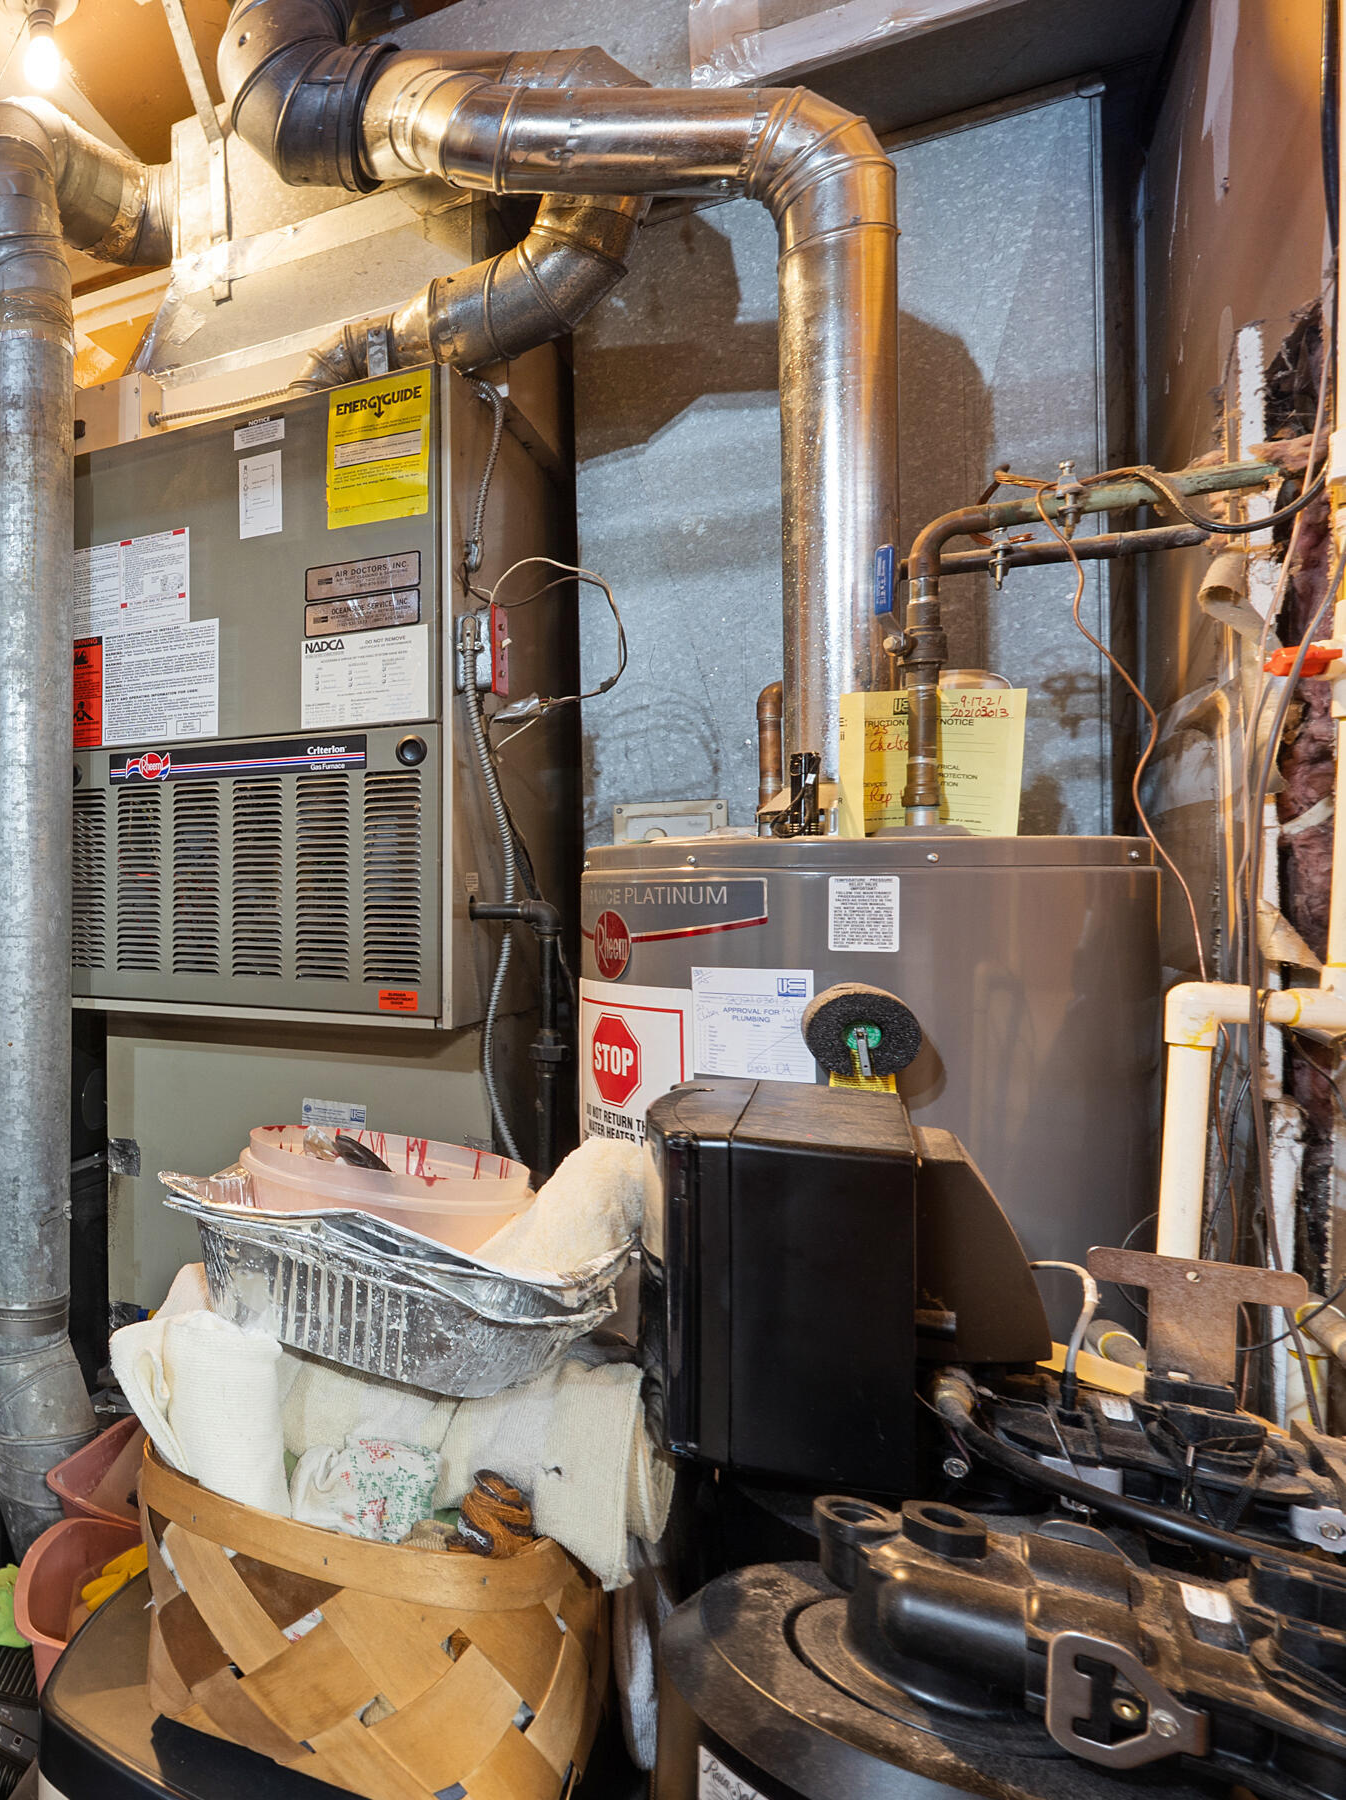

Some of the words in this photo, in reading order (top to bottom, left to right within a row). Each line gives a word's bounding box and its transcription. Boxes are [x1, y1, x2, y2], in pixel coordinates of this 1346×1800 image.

[336, 386, 422, 417] ENERGYGUIDE
[248, 416, 271, 426] NOTICE
[305, 639, 344, 654] NADCA
[307, 745, 345, 755] Criterion
[141, 755, 163, 773] Rheem
[322, 762, 345, 770] Furnace
[625, 886, 727, 904] PLATINUM
[597, 912, 629, 969] Rheem
[723, 1007, 761, 1015] APPROVAL
[732, 1015, 770, 1023] PLUMBING
[594, 1041, 634, 1077] STOP
[604, 1110, 633, 1130] RETURN
[636, 1118, 646, 1132] TH
